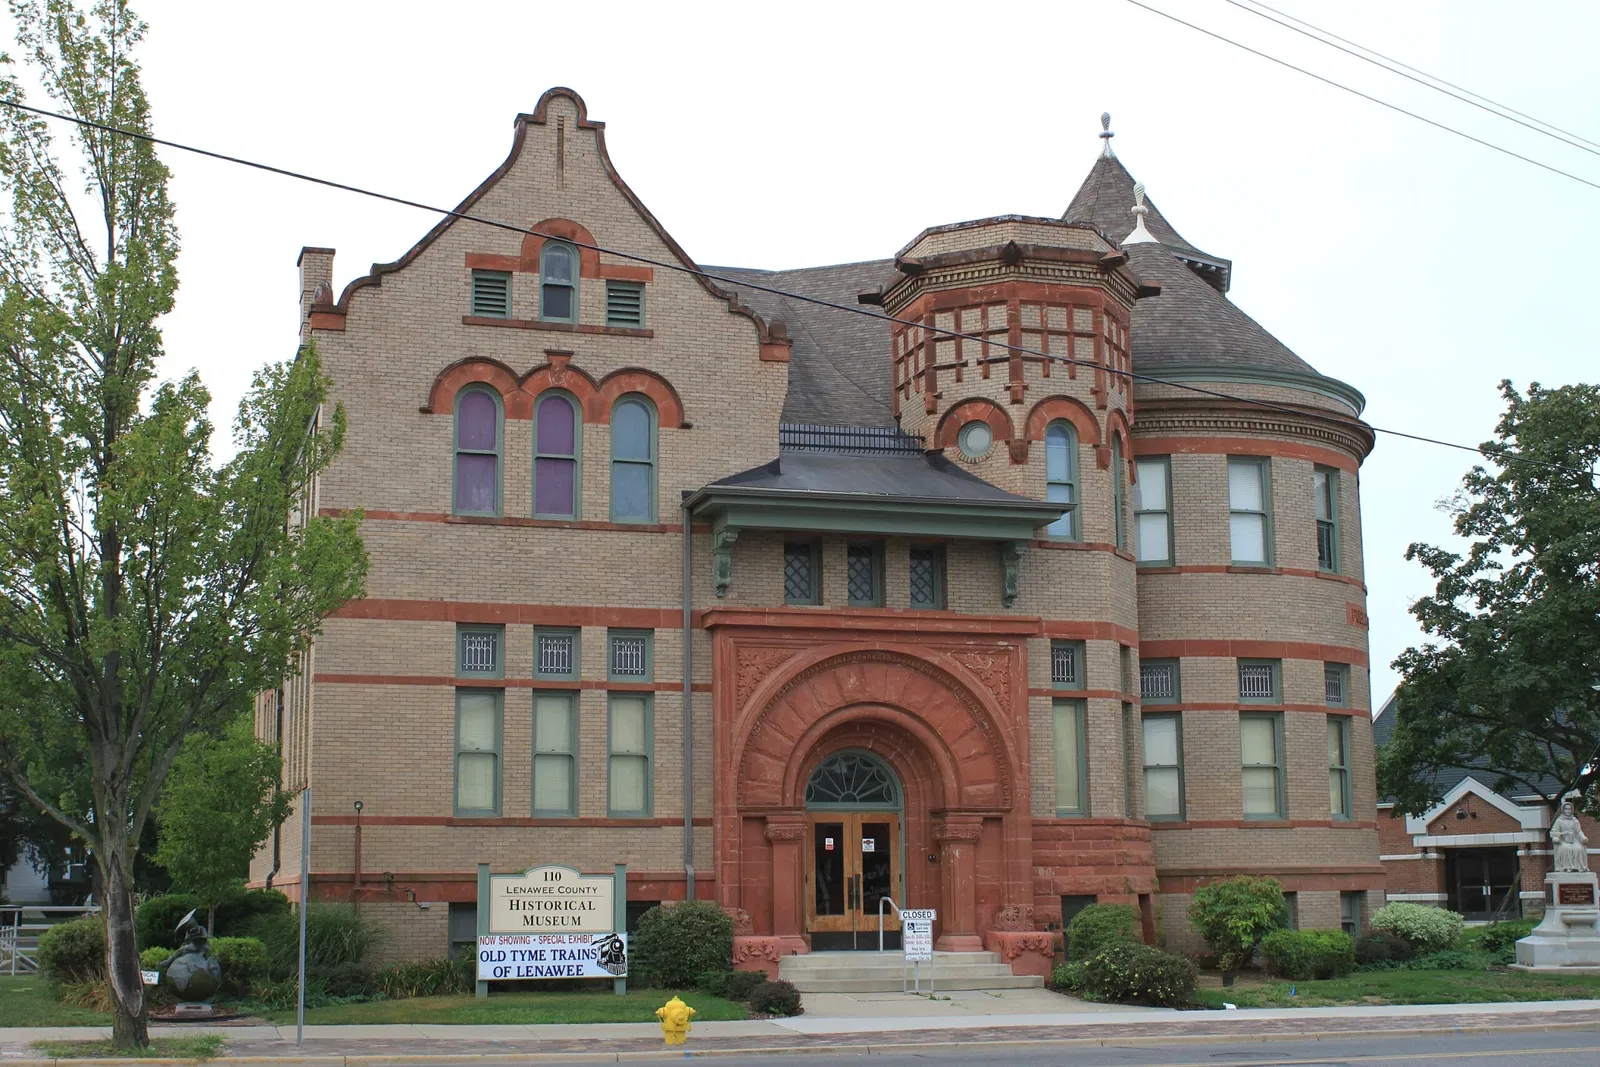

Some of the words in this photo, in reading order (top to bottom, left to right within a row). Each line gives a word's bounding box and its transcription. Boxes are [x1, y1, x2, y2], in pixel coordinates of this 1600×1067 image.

[544, 871, 562, 881] 110
[506, 886, 555, 894] LENAWEE
[557, 886, 598, 894] COUNTY
[509, 899, 596, 911] HISTORICAL
[522, 914, 582, 926] MUSEUM
[902, 911, 932, 919] CLOSED
[480, 935, 496, 945] NOW
[498, 935, 531, 945] SHOWING
[538, 935, 566, 944] SPECIAL
[568, 934, 594, 944] EXHIBIT
[479, 950, 507, 962] OLD
[510, 949, 547, 962] TYME
[550, 948, 598, 961] TRAINS
[492, 965, 512, 978] OF
[516, 964, 585, 977] LENAWEE
